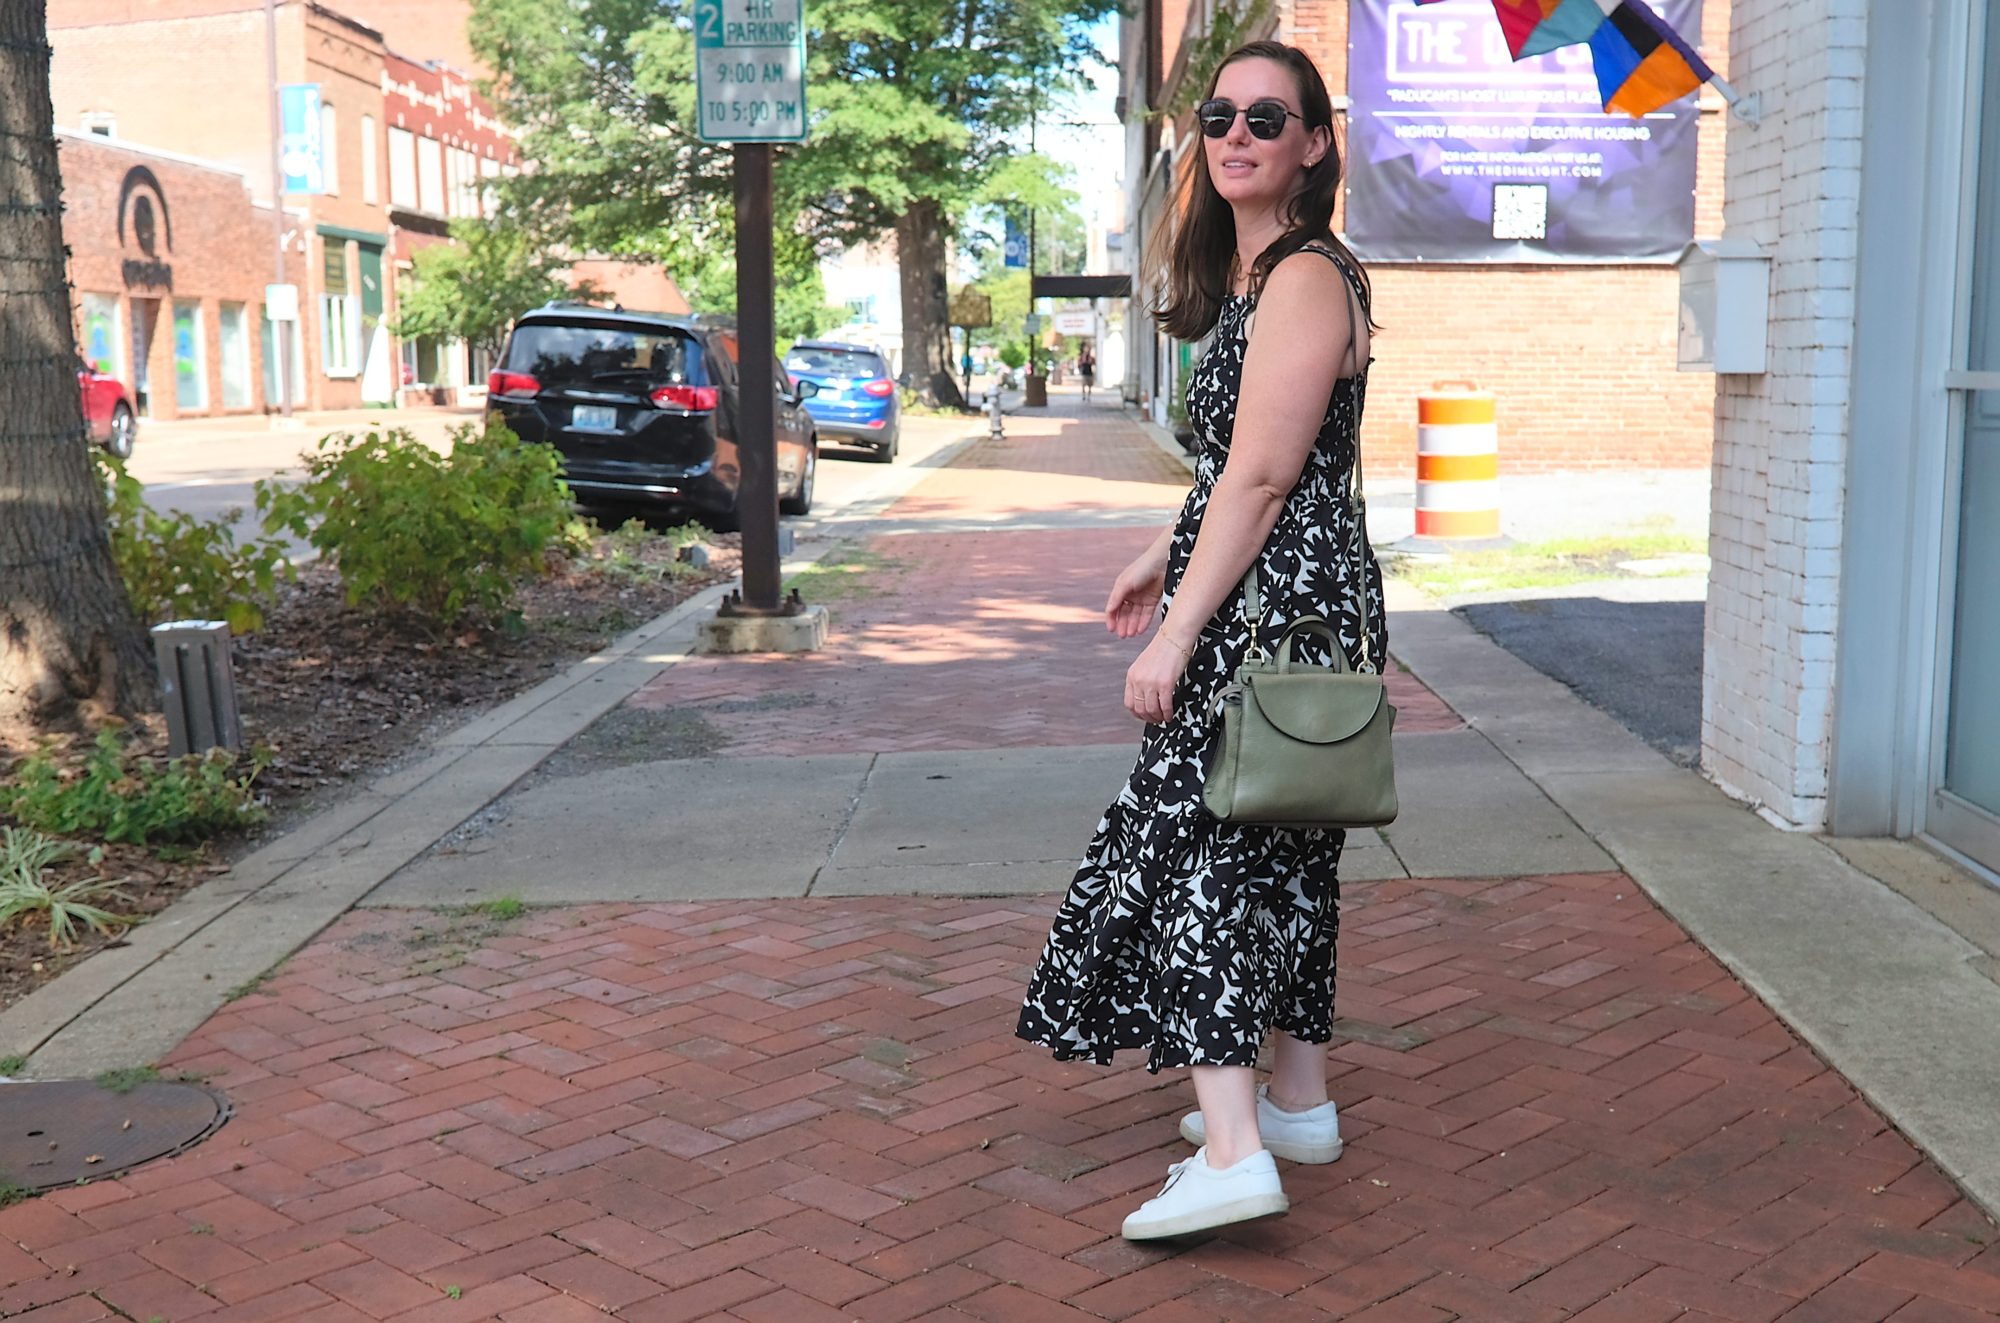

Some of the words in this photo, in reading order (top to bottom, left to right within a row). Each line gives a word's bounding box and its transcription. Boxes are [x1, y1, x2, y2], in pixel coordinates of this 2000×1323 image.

[748, 0, 773, 19] HR
[701, 3, 719, 38] 2
[727, 22, 796, 42] PARKING
[1402, 21, 1467, 63] THE
[717, 63, 756, 83] 9:00
[762, 63, 784, 83] AM
[1461, 89, 1497, 102] MOST
[1499, 90, 1565, 103] LUXURIOUS
[708, 101, 726, 121] TO
[732, 101, 769, 122] 5:00
[775, 101, 796, 121] PM
[1395, 125, 1446, 138] NIGHTLY
[1447, 125, 1500, 139] RENTALS
[1502, 126, 1529, 139] AND
[1530, 126, 1593, 140] EXECUTIVE
[1594, 127, 1650, 140] HOUSING
[1440, 151, 1460, 162] FOR
[1460, 152, 1488, 163] MORE
[1489, 152, 1552, 163] INFORMATION
[1441, 165, 1602, 177] WWW.THEDIMLIGHT.COM
